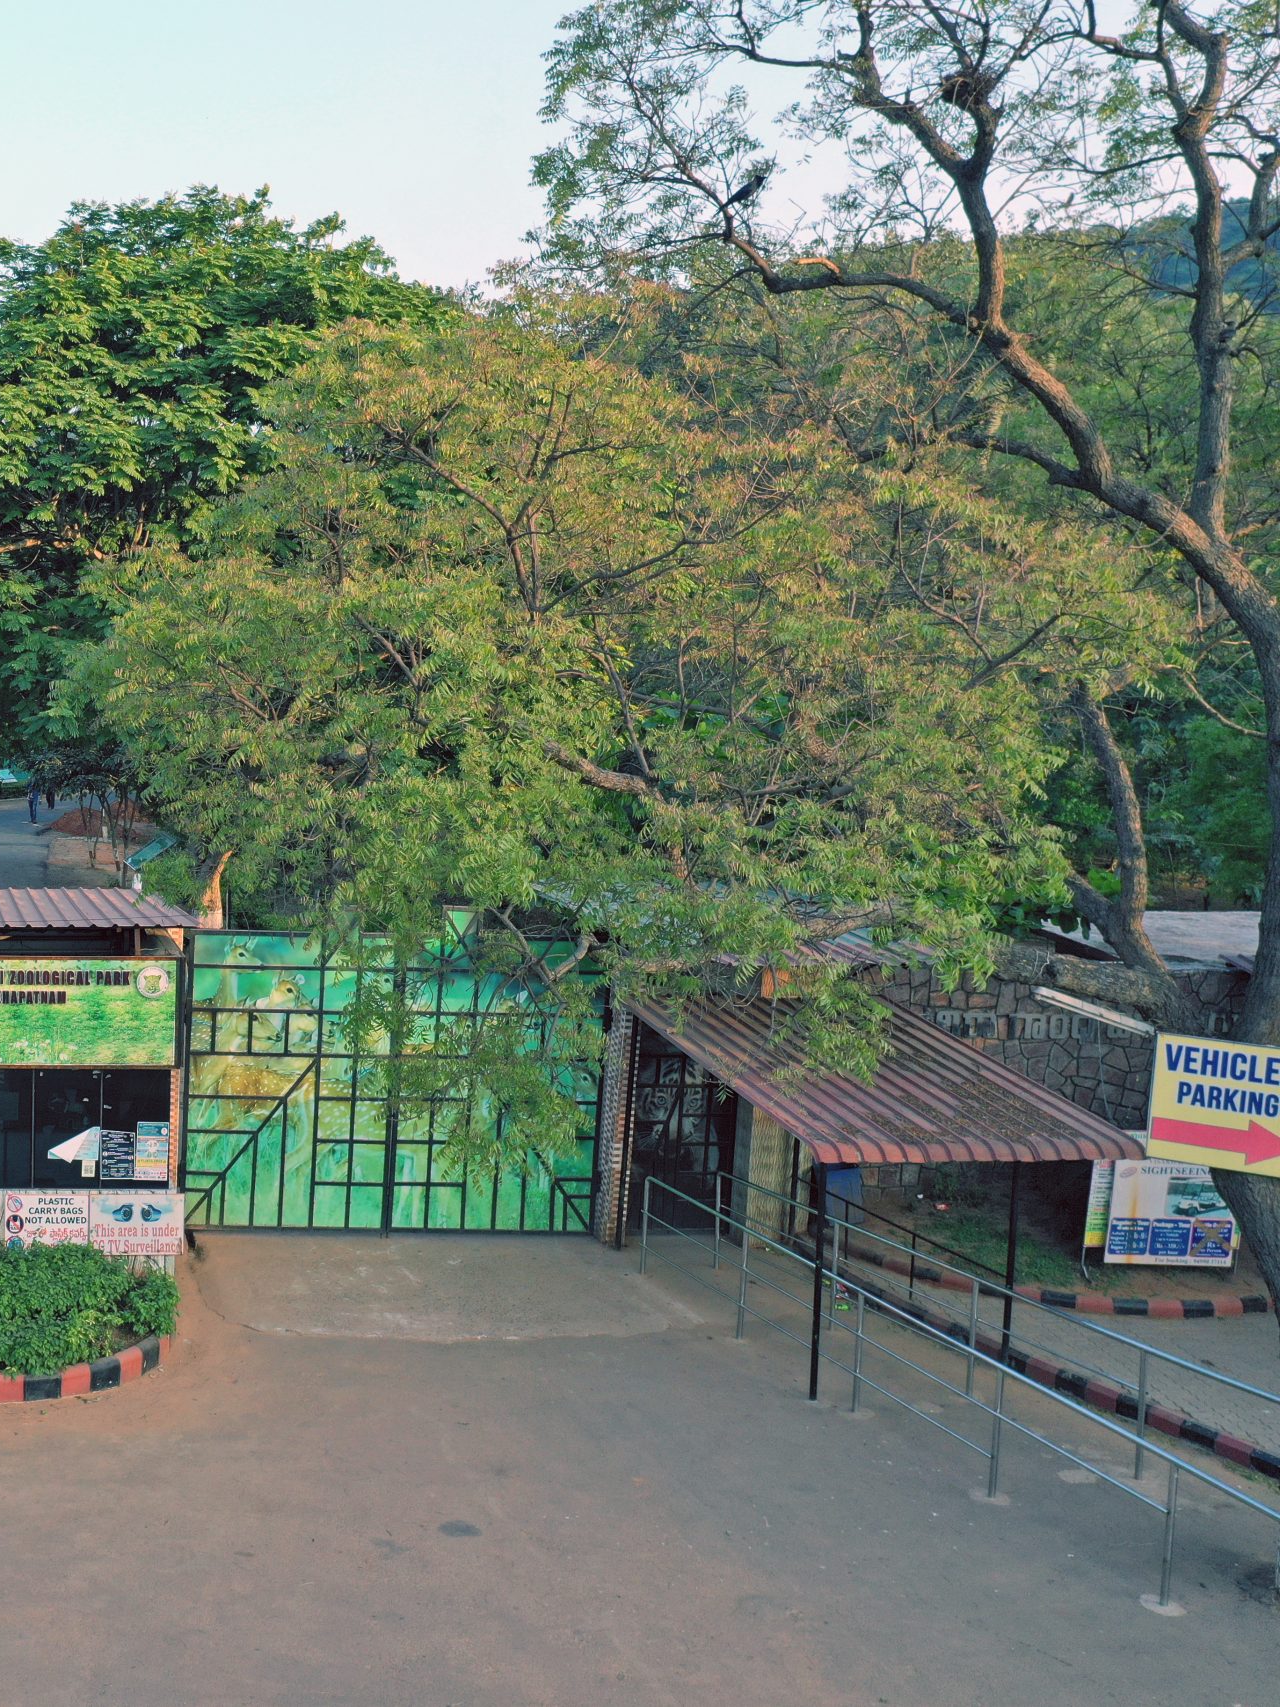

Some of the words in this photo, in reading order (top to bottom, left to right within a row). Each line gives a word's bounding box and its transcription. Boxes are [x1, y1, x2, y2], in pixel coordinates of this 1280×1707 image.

[9, 968, 91, 985] ZOOLOGICAL
[96, 968, 131, 985] PARK
[1165, 1043, 1280, 1086] VEHICLE
[1176, 1081, 1280, 1117] PARKING
[38, 1197, 74, 1205] PLASTIC
[29, 1207, 59, 1215] CARRY
[60, 1207, 84, 1215] BAGS
[25, 1216, 43, 1224] NOT
[45, 1216, 87, 1224] ALLOWED
[95, 1223, 115, 1237] This
[117, 1226, 138, 1237] area
[141, 1223, 149, 1237] is
[152, 1223, 180, 1237] under
[108, 1239, 121, 1252] TV
